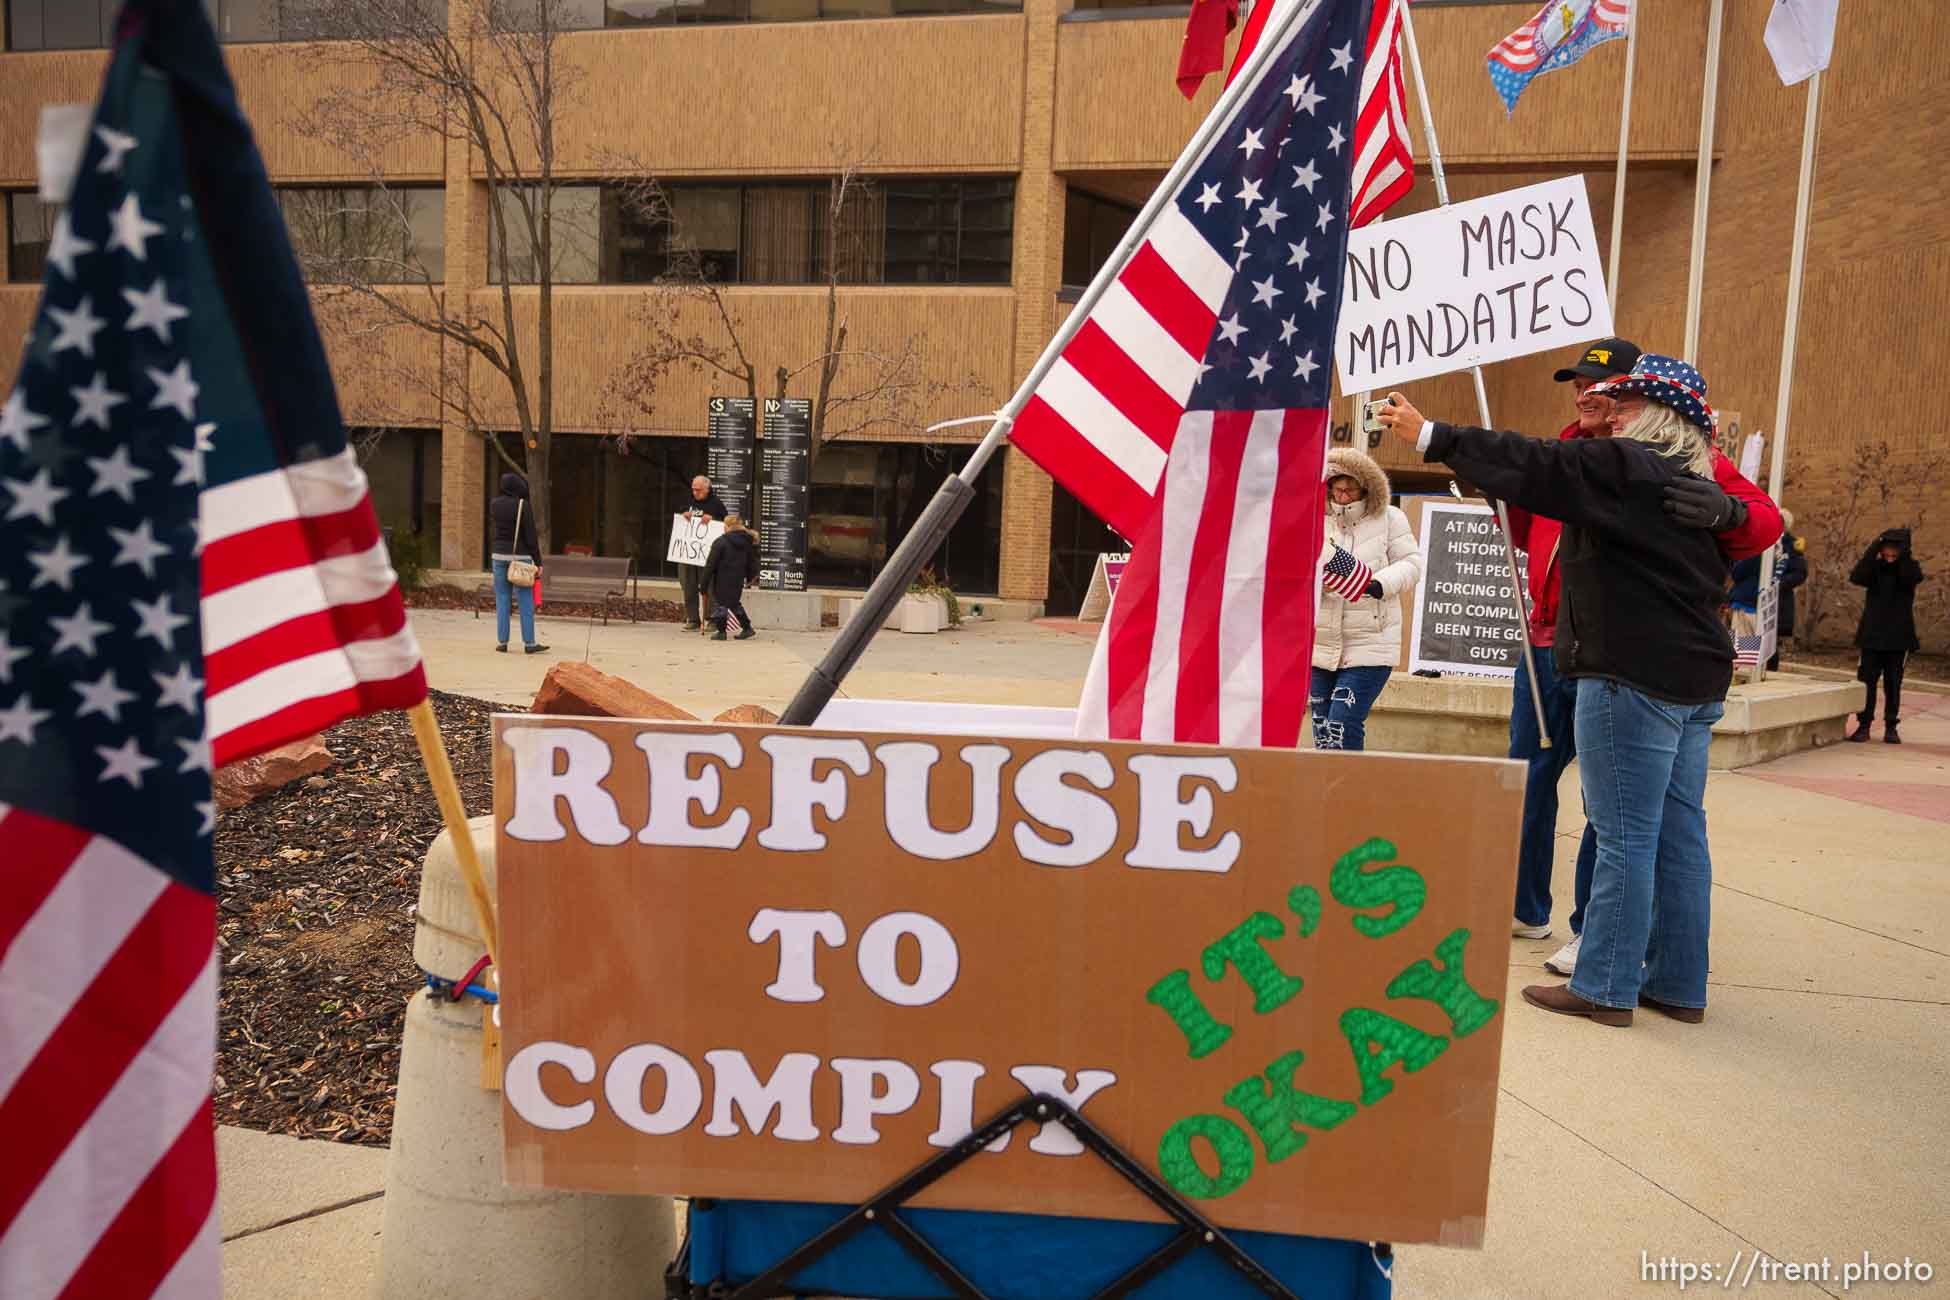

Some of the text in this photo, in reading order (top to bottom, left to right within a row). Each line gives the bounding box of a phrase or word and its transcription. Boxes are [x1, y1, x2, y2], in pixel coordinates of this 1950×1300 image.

[1347, 197, 1582, 303] NO MASK
[1348, 268, 1593, 377] MANDATES
[1445, 521, 1464, 532] AT
[1467, 523, 1489, 535] NO
[1448, 542, 1506, 556] HISTORY
[784, 571, 803, 579] North
[1456, 562, 1482, 575] THE
[1435, 582, 1496, 597] FORCING
[1428, 602, 1462, 615] INTO
[1435, 623, 1470, 637] BEEN
[1474, 626, 1500, 639] THE
[1470, 646, 1508, 661] GUYS
[503, 727, 1241, 873] REFUSE
[1145, 837, 1427, 1060] IT'S
[749, 908, 960, 1006] TO
[1157, 928, 1499, 1200] OKAY
[504, 1041, 1117, 1156] COMPLY
